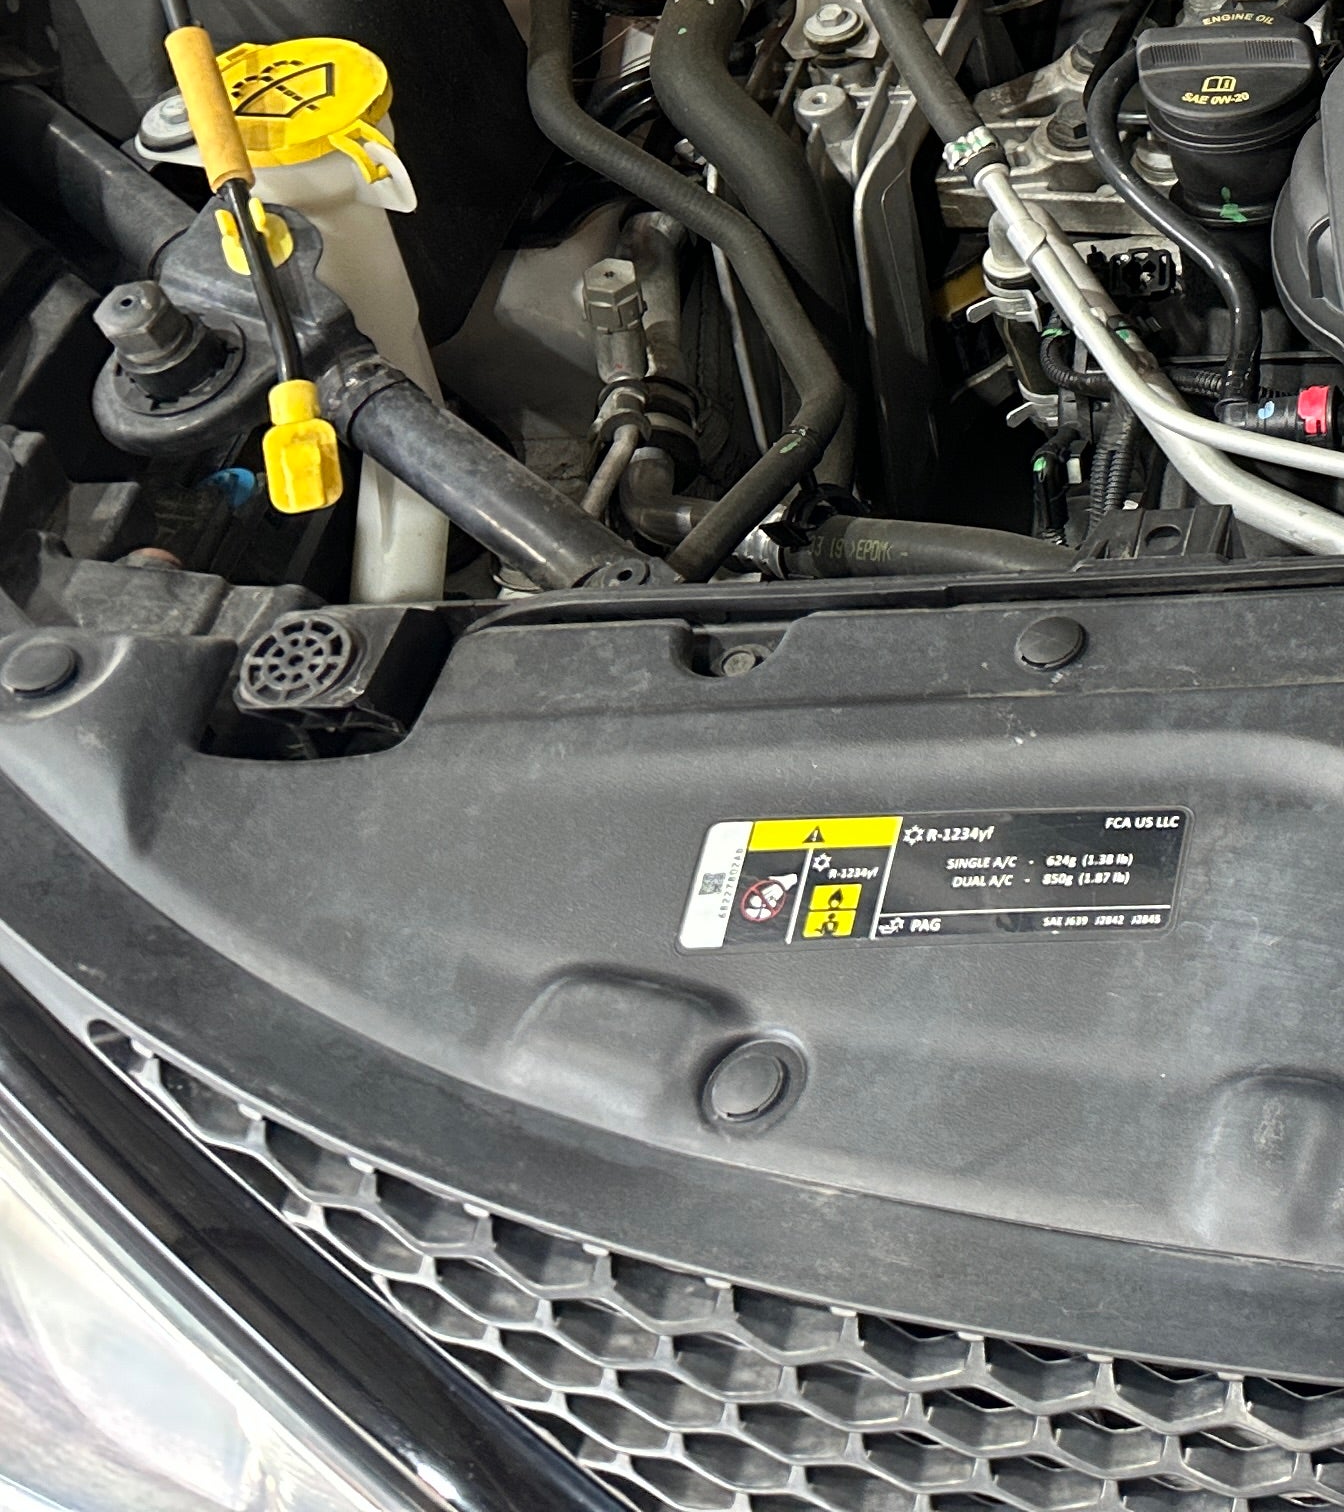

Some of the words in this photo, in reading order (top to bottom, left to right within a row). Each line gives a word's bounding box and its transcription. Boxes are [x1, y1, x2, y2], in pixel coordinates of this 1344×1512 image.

[1202, 13, 1255, 26] ENGINE
[1255, 14, 1275, 25] OIL
[1181, 92, 1207, 105] SAE
[1210, 92, 1250, 105] 0W-20
[1105, 817, 1132, 829] FCA
[1134, 817, 1154, 829] US
[1155, 815, 1180, 829] LLC
[926, 826, 995, 843] R-1234yf
[946, 857, 991, 870] SINGLE
[992, 855, 1018, 869] A/C
[1045, 854, 1077, 868] 624g
[1081, 853, 1114, 868] (1.38
[1115, 853, 1134, 867] lb)
[828, 866, 879, 880] R-1234yf
[952, 875, 987, 888] DUAL
[988, 874, 1014, 888] A/C
[1042, 873, 1074, 887] 850g
[1111, 871, 1130, 885] lb)
[910, 918, 942, 932] PAG
[1043, 916, 1063, 927] SAE
